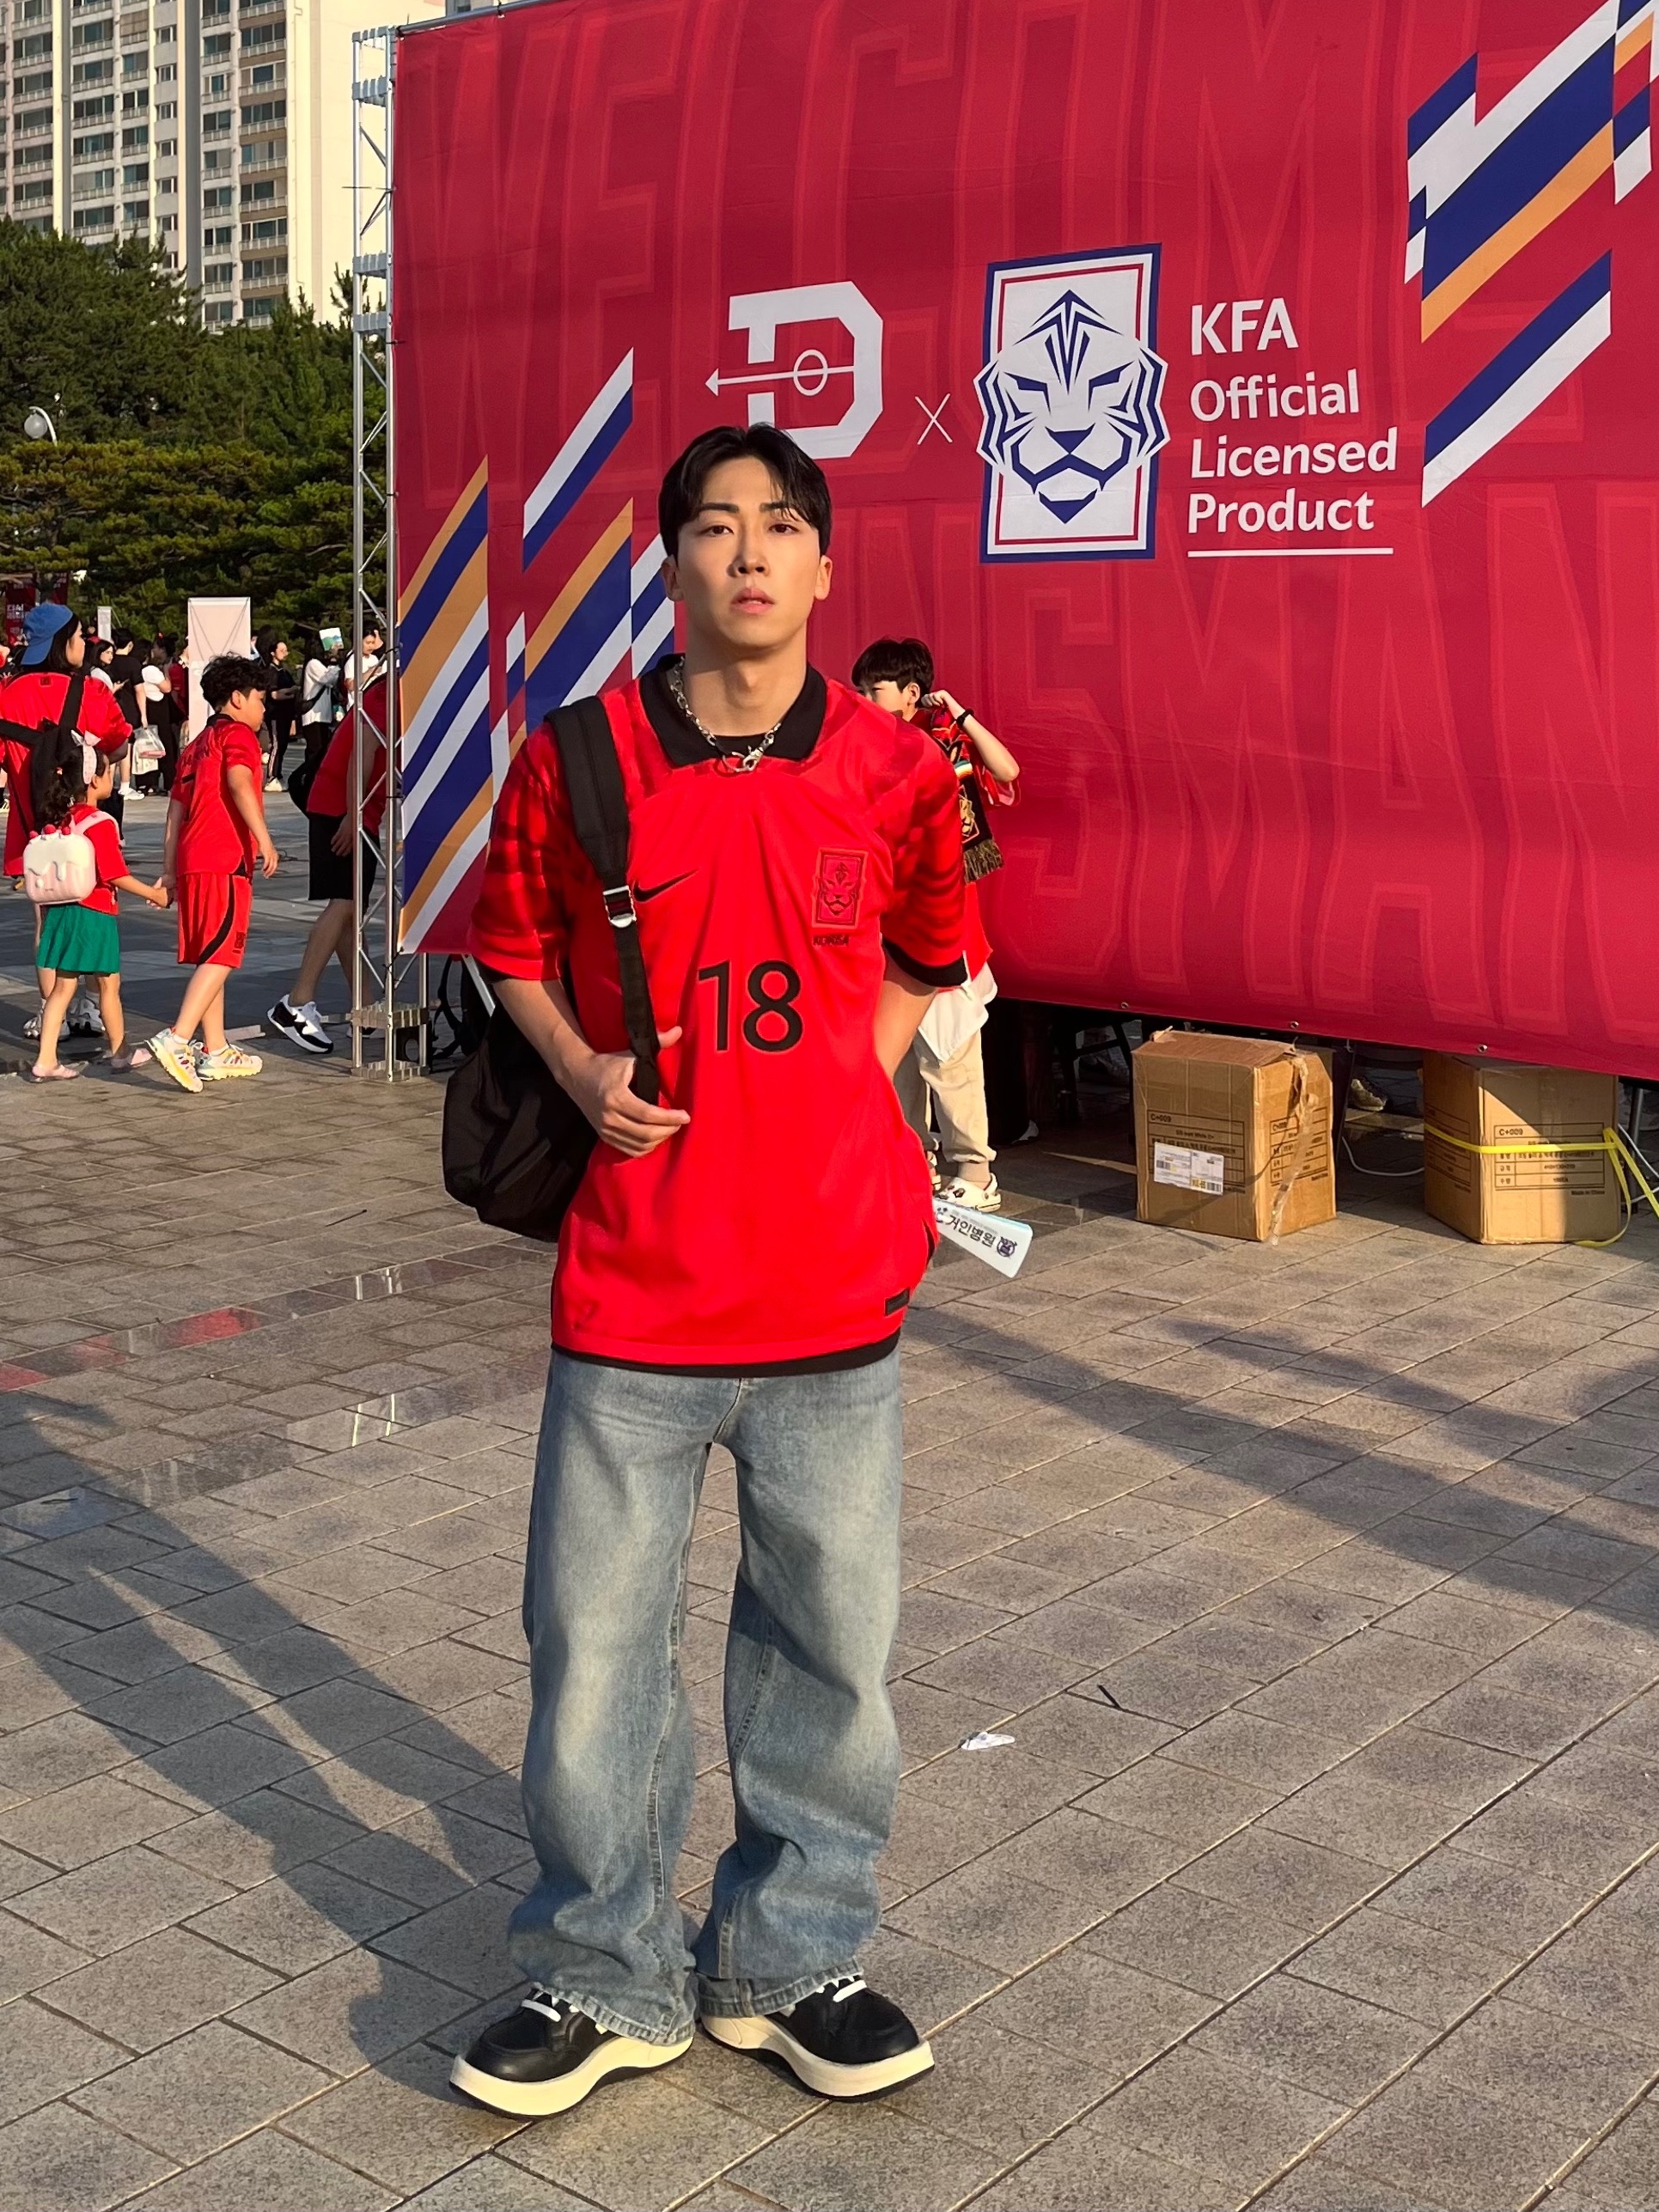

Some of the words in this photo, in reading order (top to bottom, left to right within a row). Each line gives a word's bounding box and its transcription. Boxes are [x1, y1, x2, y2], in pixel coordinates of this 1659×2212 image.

[1190, 297, 1299, 356] KFA
[1190, 369, 1360, 422] Official
[1191, 427, 1398, 479] Licensed
[1188, 487, 1375, 534] Product
[697, 959, 803, 1053] 18
[948, 1214, 997, 1248] 거인병원
